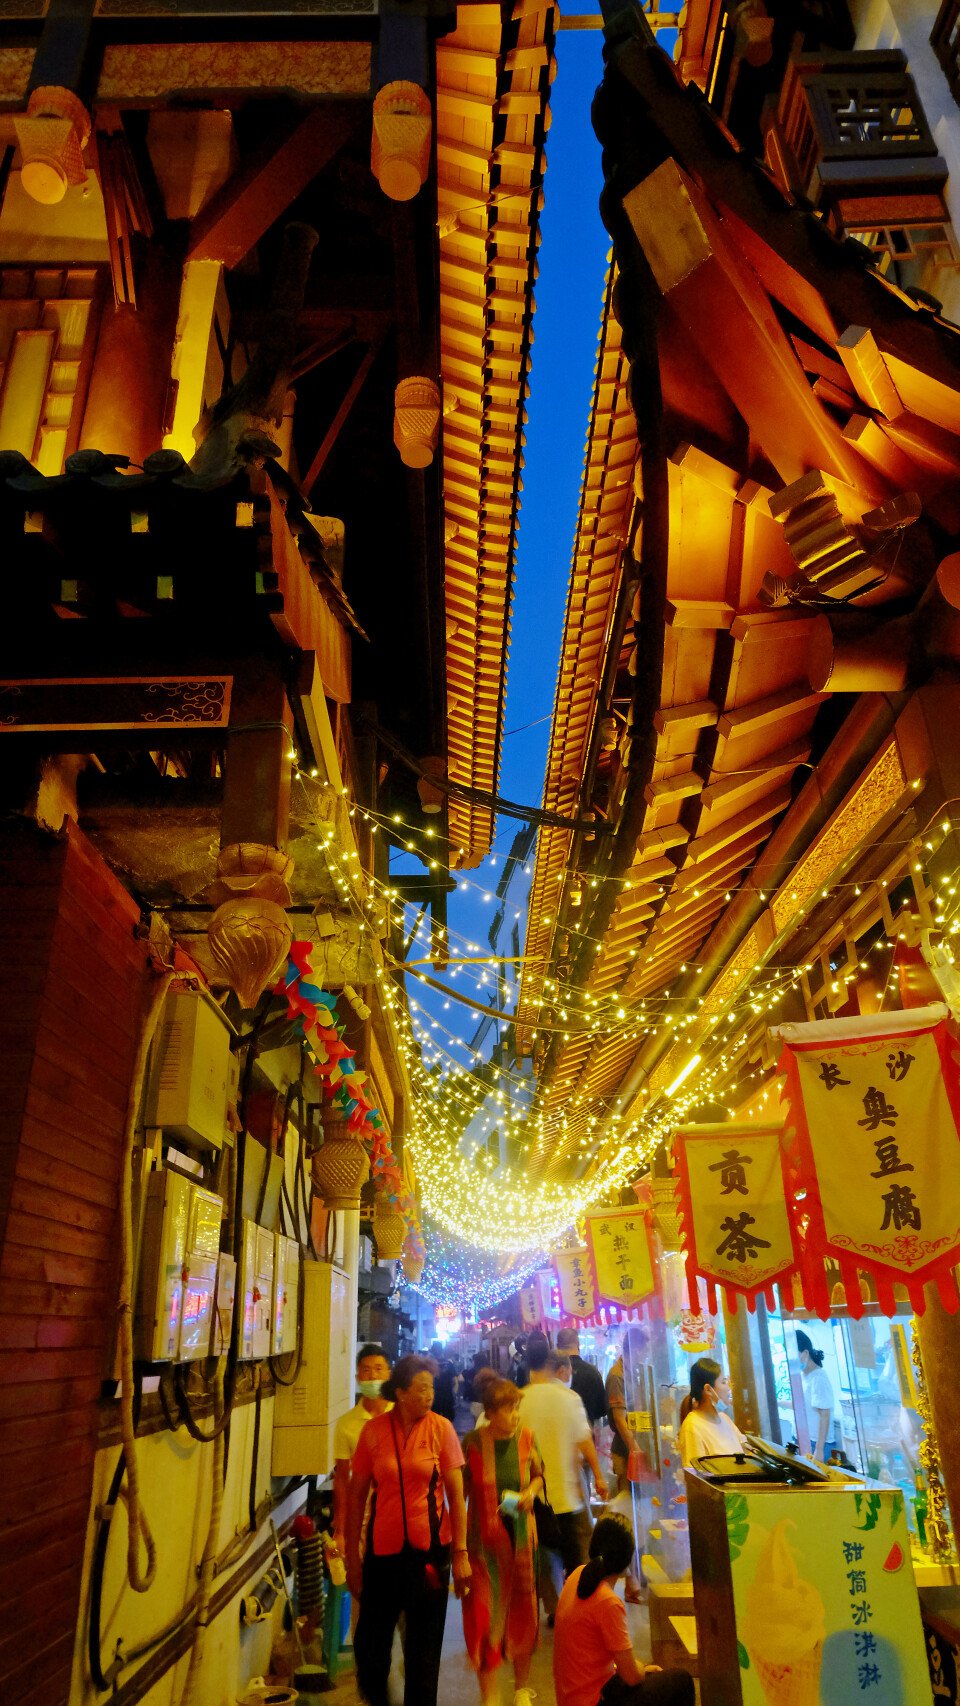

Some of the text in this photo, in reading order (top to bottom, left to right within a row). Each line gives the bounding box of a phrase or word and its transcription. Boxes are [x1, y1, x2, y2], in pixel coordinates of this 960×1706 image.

[819, 1051, 915, 1090] 长沙
[600, 1222, 637, 1236] 武汉
[708, 1150, 771, 1263] 贡茶
[570, 1257, 588, 1308] 章鱼小丸子
[613, 1235, 634, 1291] 热干面
[843, 1541, 881, 1689] 甜筒冰淇淋
